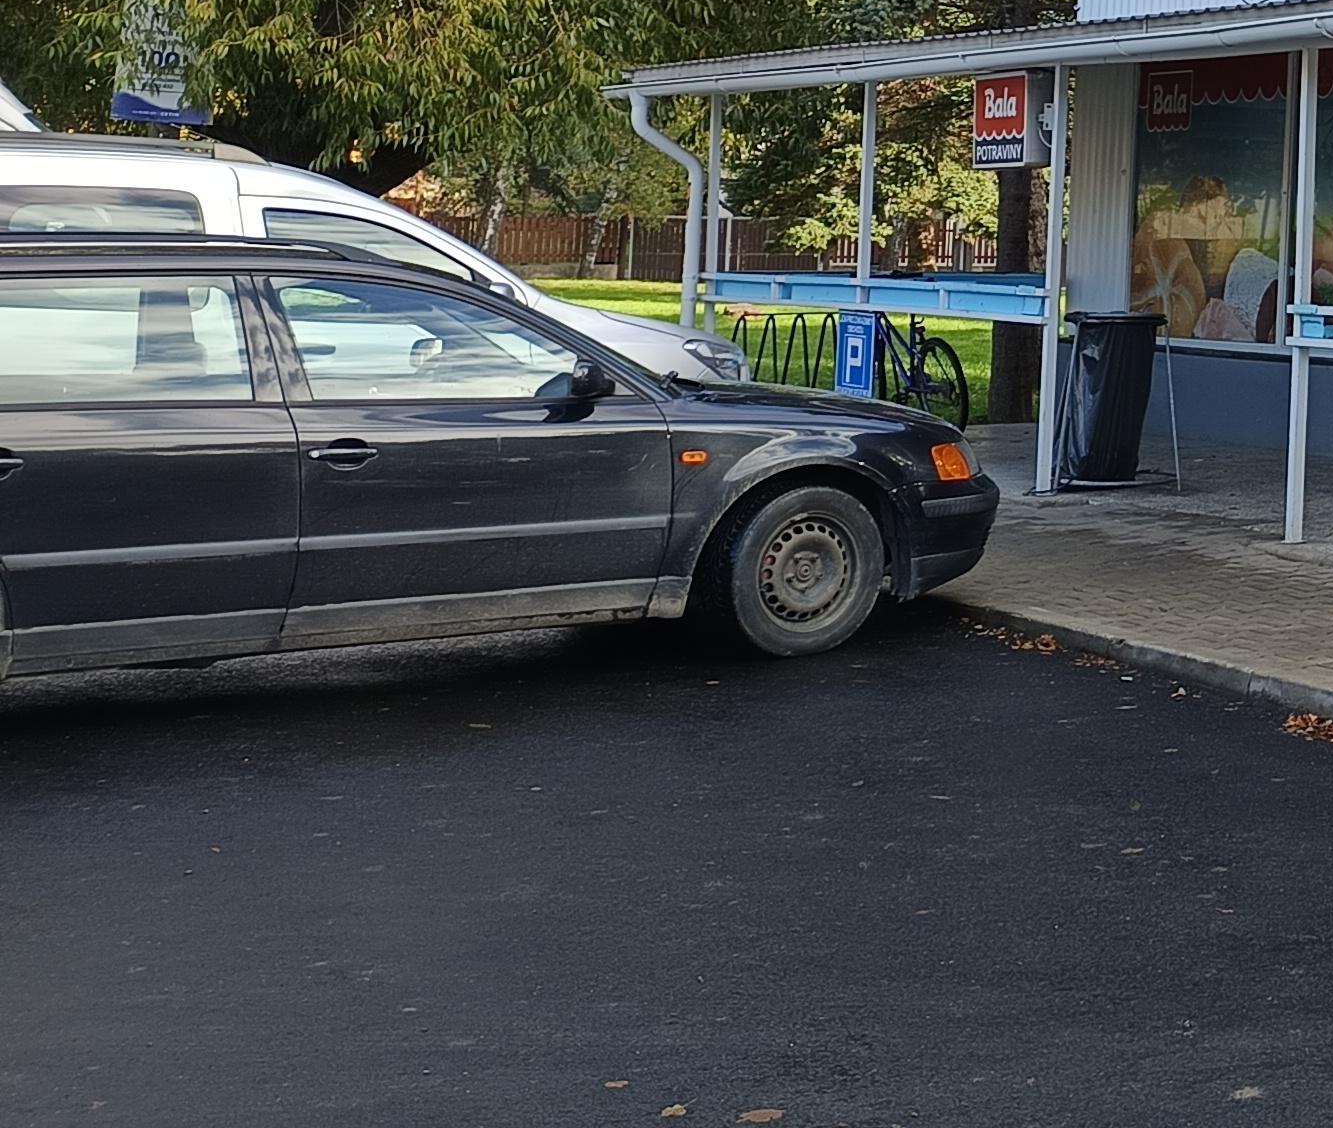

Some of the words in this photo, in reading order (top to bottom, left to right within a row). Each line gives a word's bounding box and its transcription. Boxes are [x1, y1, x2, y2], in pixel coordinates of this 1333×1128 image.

[984, 87, 1017, 119] Bala
[1152, 83, 1187, 115] Bala
[976, 143, 1022, 161] POTRAVINY
[845, 337, 863, 383] P
